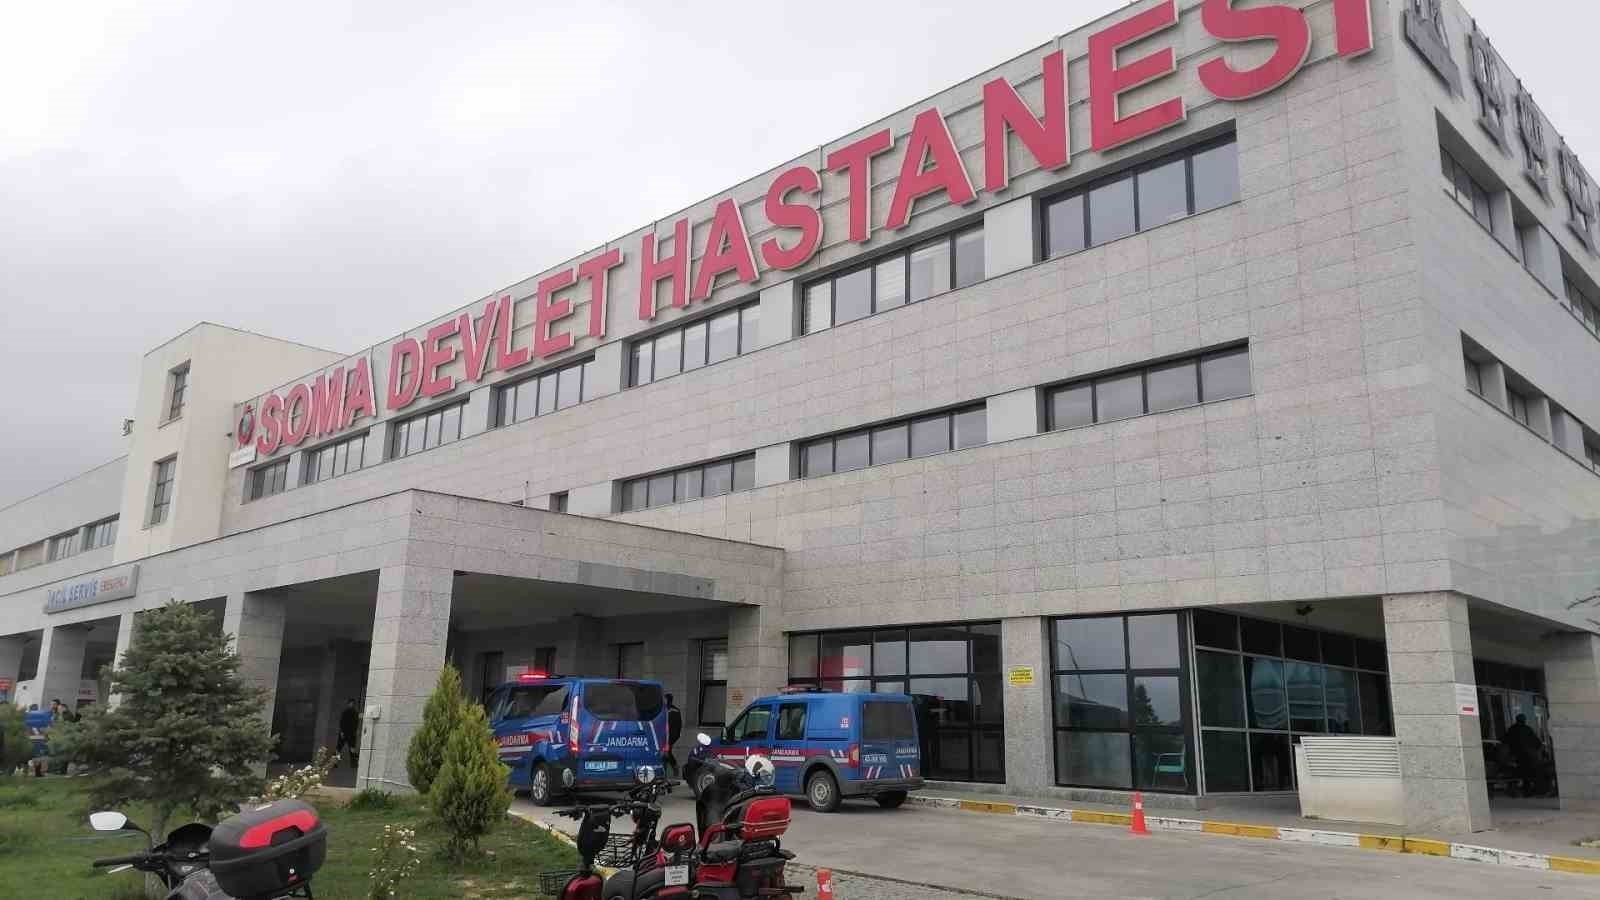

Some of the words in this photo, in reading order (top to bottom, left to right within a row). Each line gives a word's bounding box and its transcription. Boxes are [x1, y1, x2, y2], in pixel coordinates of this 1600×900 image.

[255, 357, 376, 456] SOMA
[386, 247, 624, 411] DEVLET
[605, 736, 649, 748] JANDARMA
